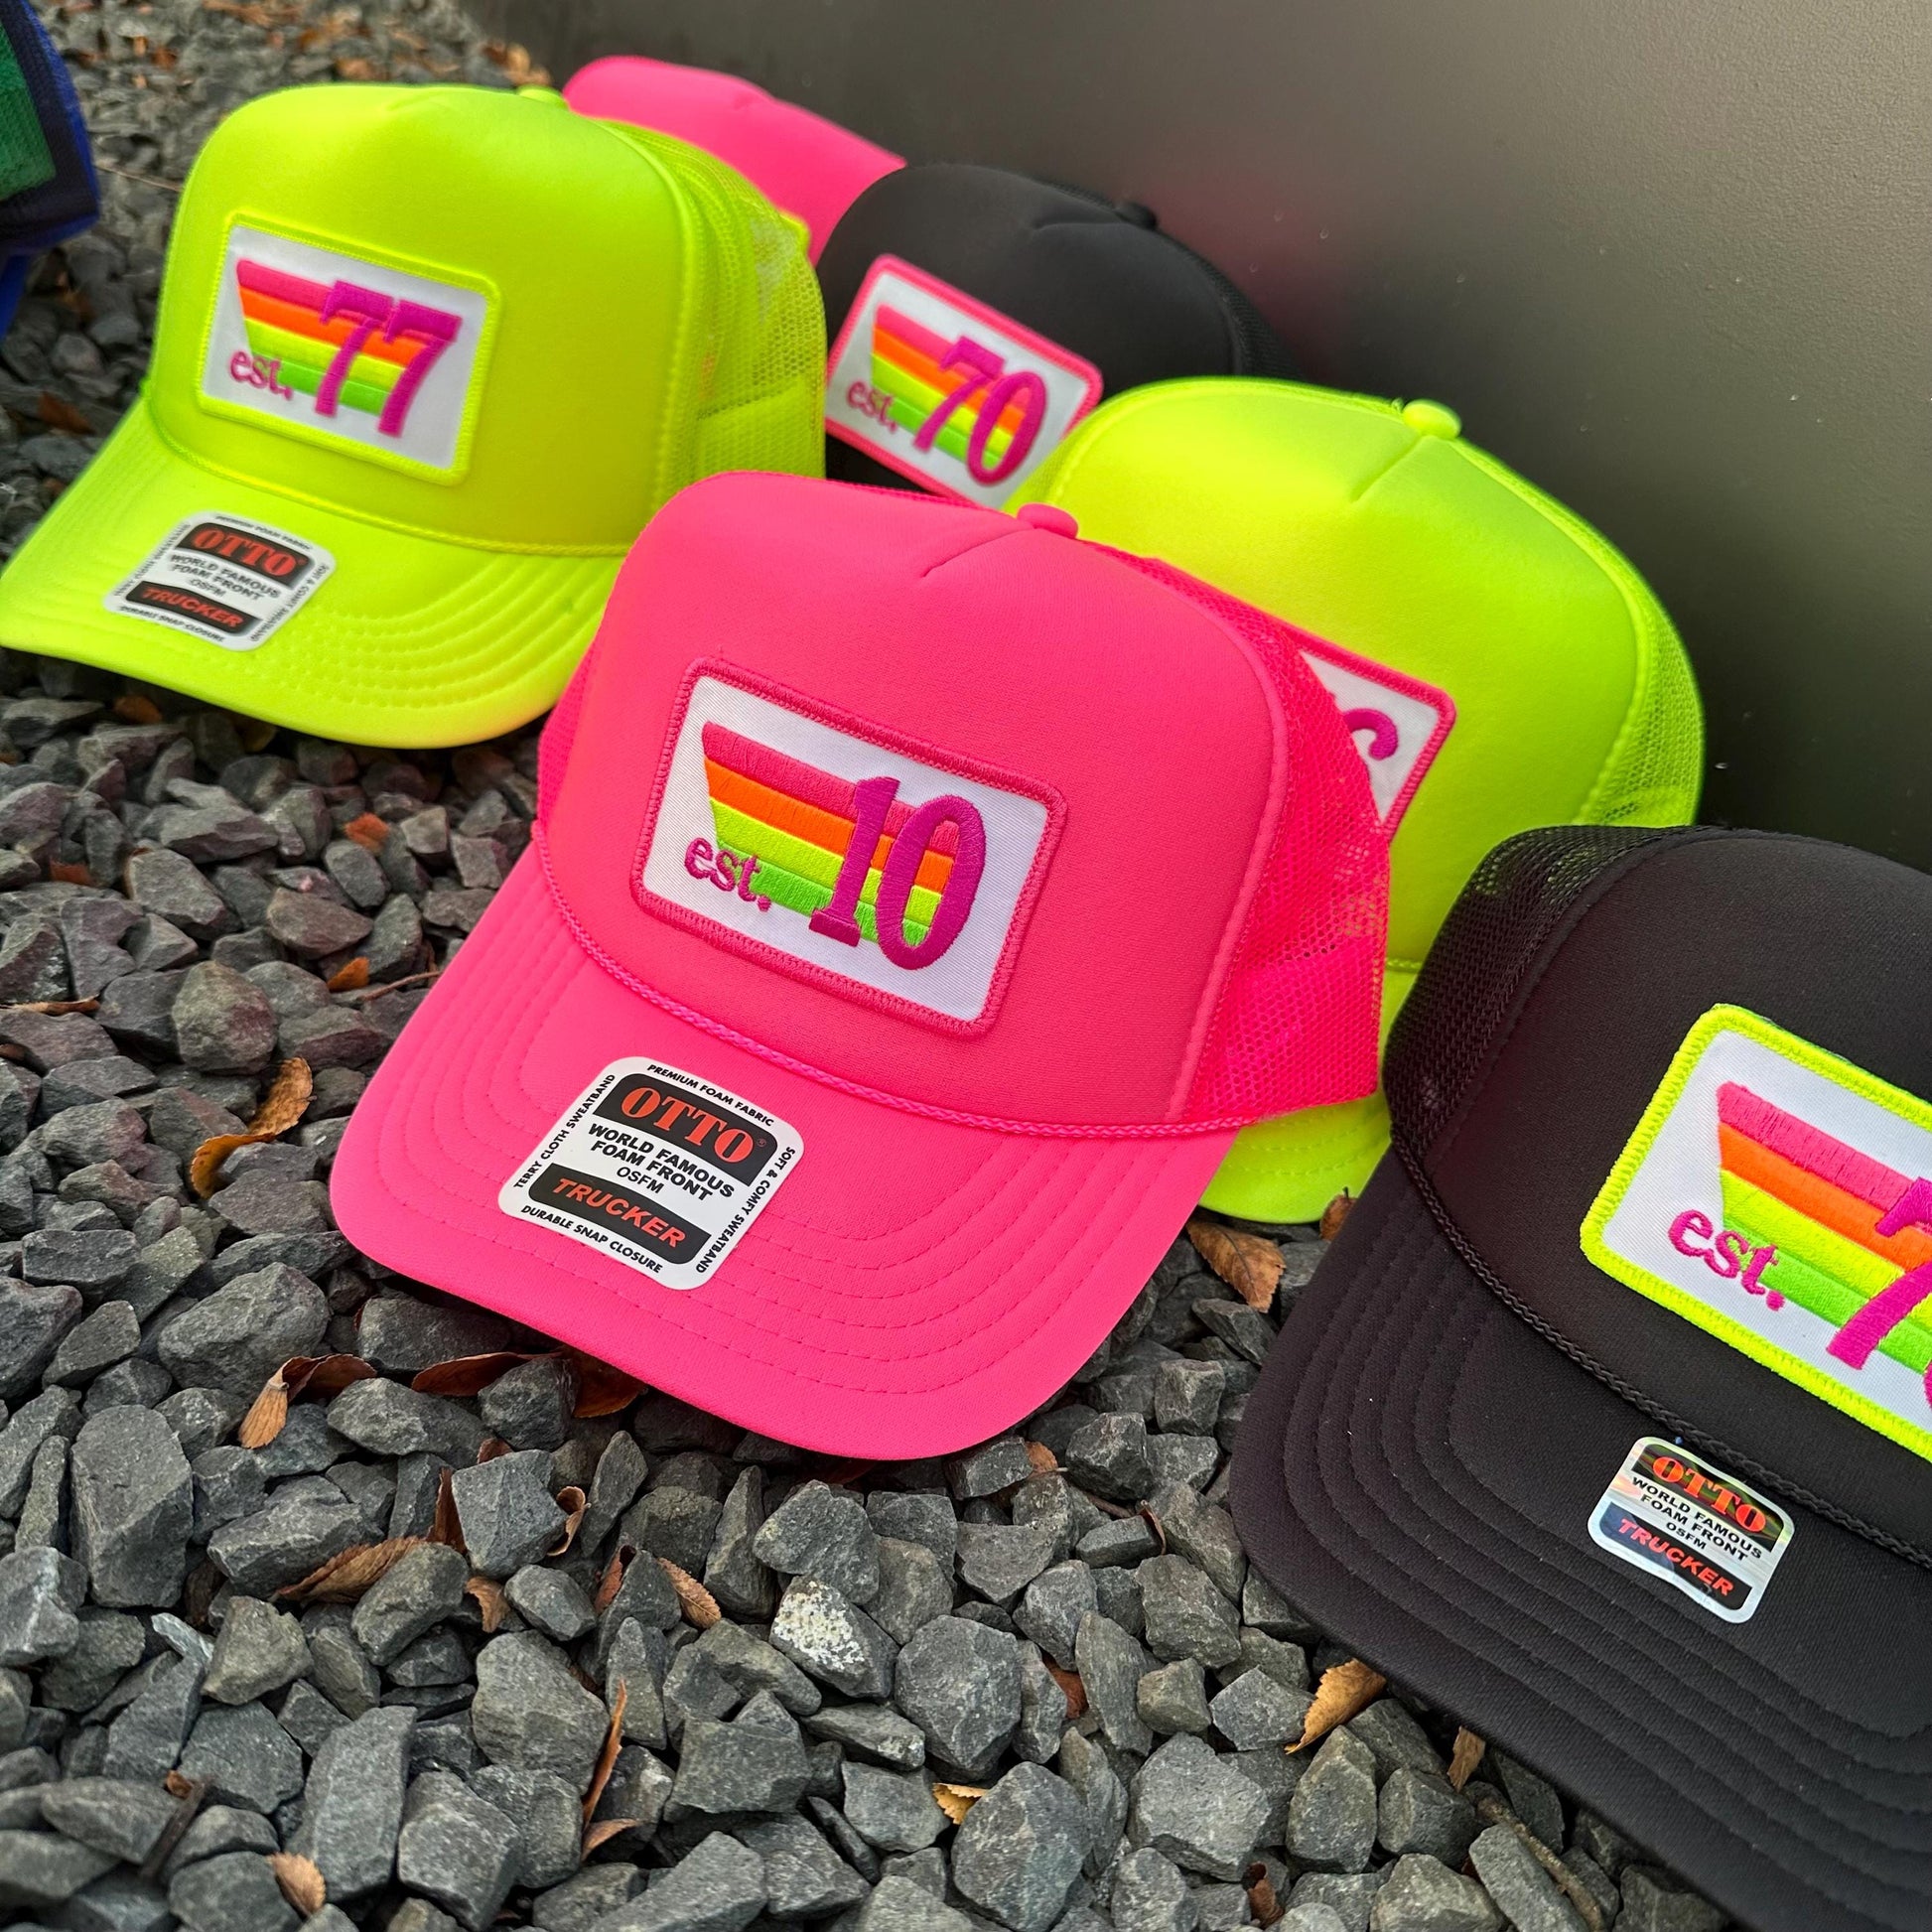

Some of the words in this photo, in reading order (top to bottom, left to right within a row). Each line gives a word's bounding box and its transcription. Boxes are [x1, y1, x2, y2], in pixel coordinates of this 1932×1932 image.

[229, 349, 293, 400] est.
[314, 279, 463, 439] 77
[846, 380, 898, 433] est.
[912, 335, 1047, 487] 70
[171, 554, 218, 575] WORLD
[221, 568, 282, 599] FAMOUS
[173, 564, 211, 583] FOAM
[213, 575, 265, 601] FRONT
[193, 528, 297, 577] OTTO
[142, 588, 244, 628] TRUCKER
[684, 837, 772, 912] est.
[808, 776, 986, 971] 10
[647, 1064, 699, 1089] PREMIUM
[699, 1085, 735, 1106] FOAM
[735, 1101, 774, 1127] FABRIC
[513, 1161, 542, 1188] TERRY
[540, 1130, 570, 1160] CLOTH
[566, 1074, 616, 1129] SWEATBAND
[588, 1123, 654, 1154] WORLD
[656, 1149, 736, 1197] FAMOUS
[774, 1147, 796, 1171] SOFT
[591, 1141, 645, 1167] FOAM
[646, 1161, 713, 1201] FRONT
[617, 1167, 664, 1194] OSFM
[742, 1179, 770, 1216] COMFY
[766, 1170, 778, 1178] &
[520, 1205, 574, 1230] DURABLE
[574, 1224, 610, 1244] SNAP
[609, 1241, 663, 1274] CLOSURE
[552, 1177, 686, 1248] TRUCKER
[695, 1214, 745, 1273] SWEATBAND
[1668, 1209, 1785, 1311] est.
[1631, 1476, 1692, 1513] WORLD
[1694, 1511, 1763, 1560] FAMOUS
[1652, 1455, 1766, 1533] OTTO
[1617, 1519, 1735, 1596] TRUCKER
[1640, 1494, 1688, 1526] FOAM
[1691, 1524, 1749, 1563] FRONT
[1665, 1522, 1708, 1550] OSFM
